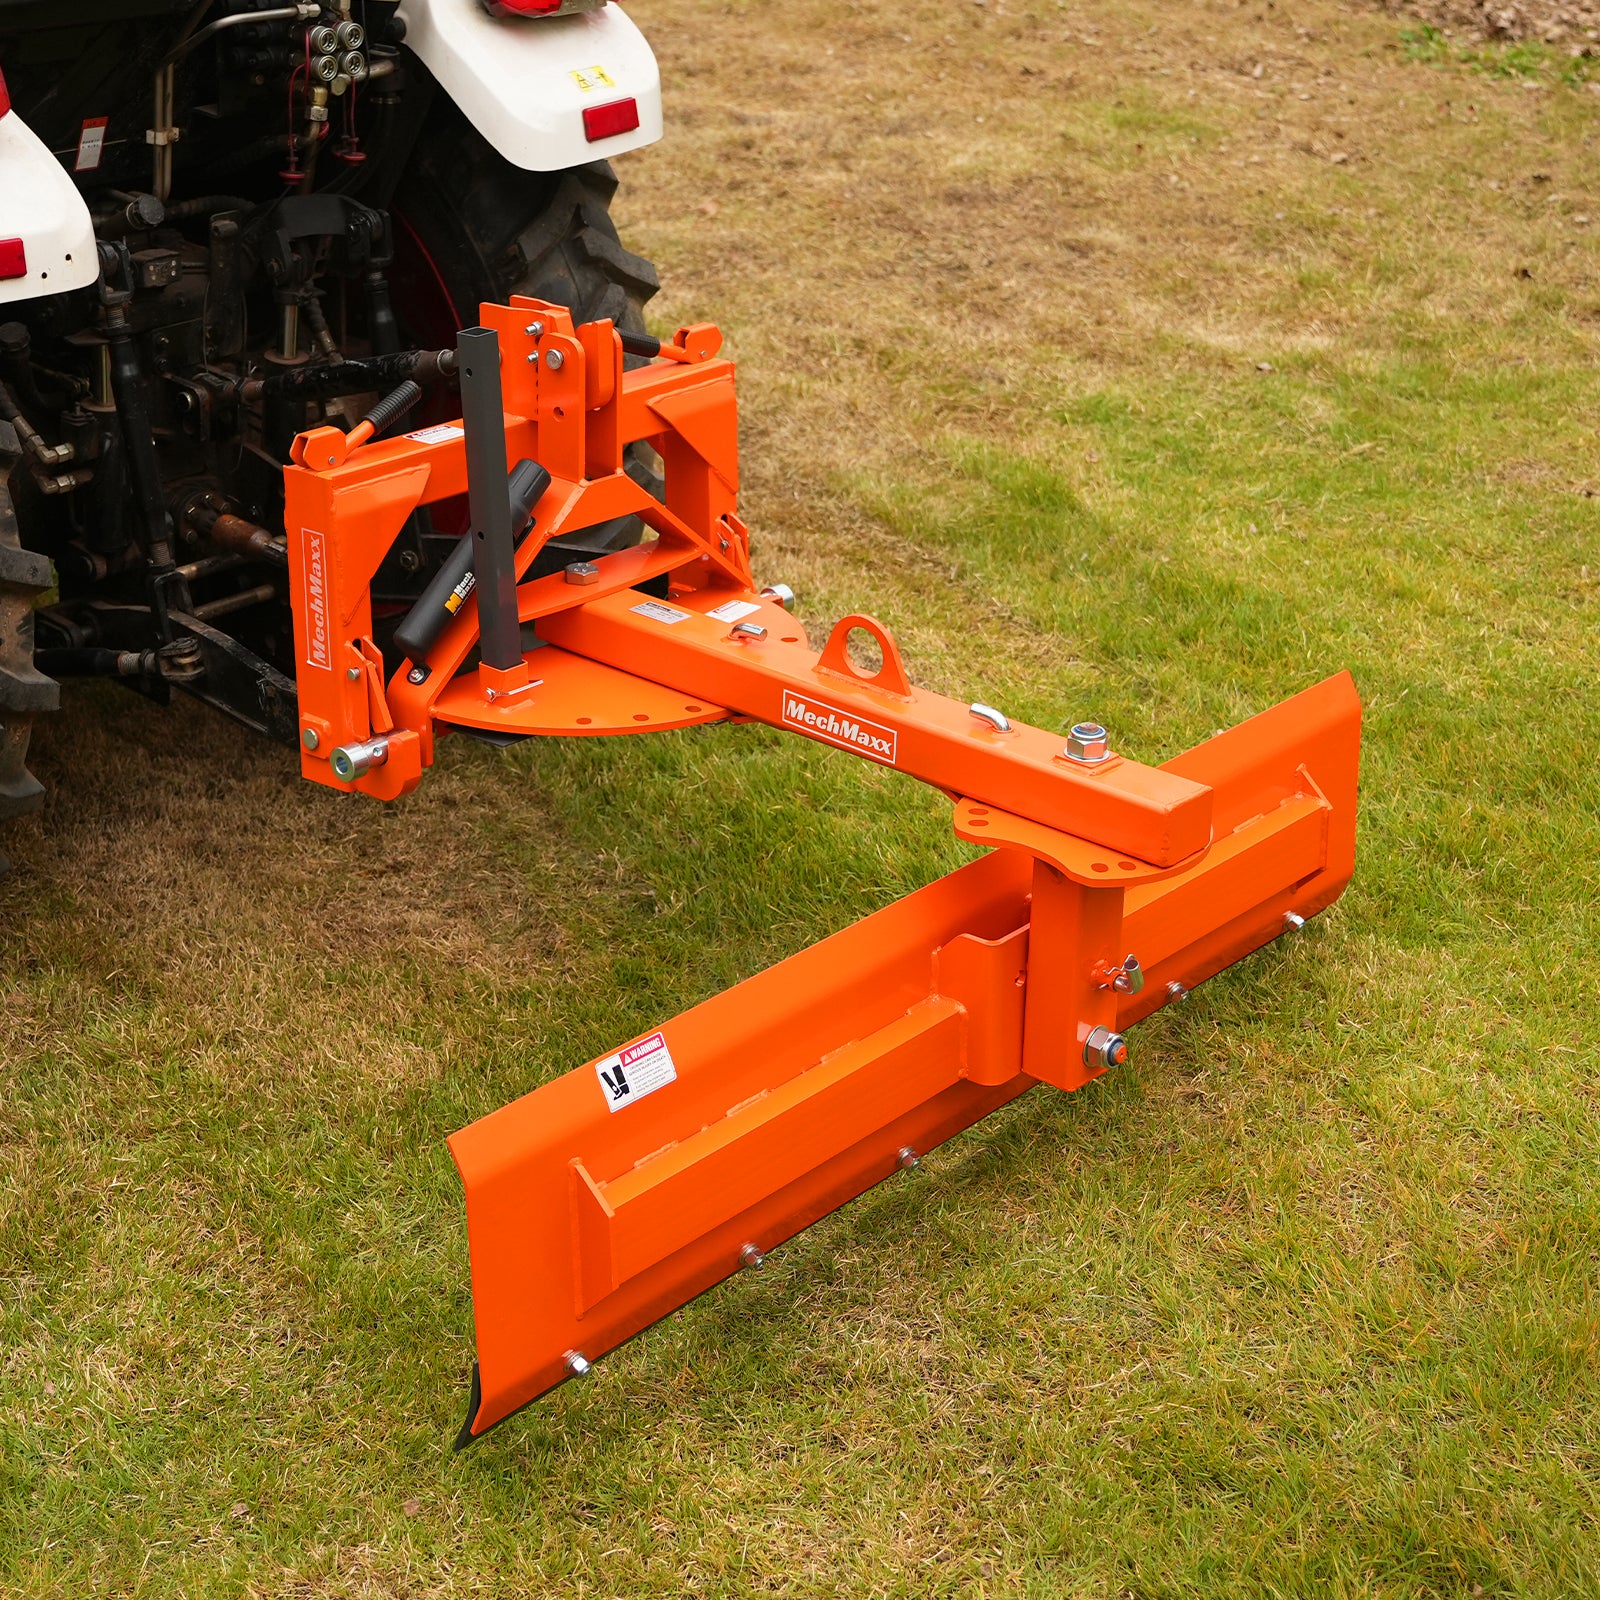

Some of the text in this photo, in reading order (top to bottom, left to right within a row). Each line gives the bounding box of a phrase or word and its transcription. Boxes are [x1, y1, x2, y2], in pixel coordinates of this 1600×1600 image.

[453, 571, 473, 596] Mech
[459, 576, 476, 600] Maxx
[310, 536, 327, 665] MechMaxx
[786, 699, 892, 755] MechMaxx
[629, 1037, 662, 1060] WARNING
